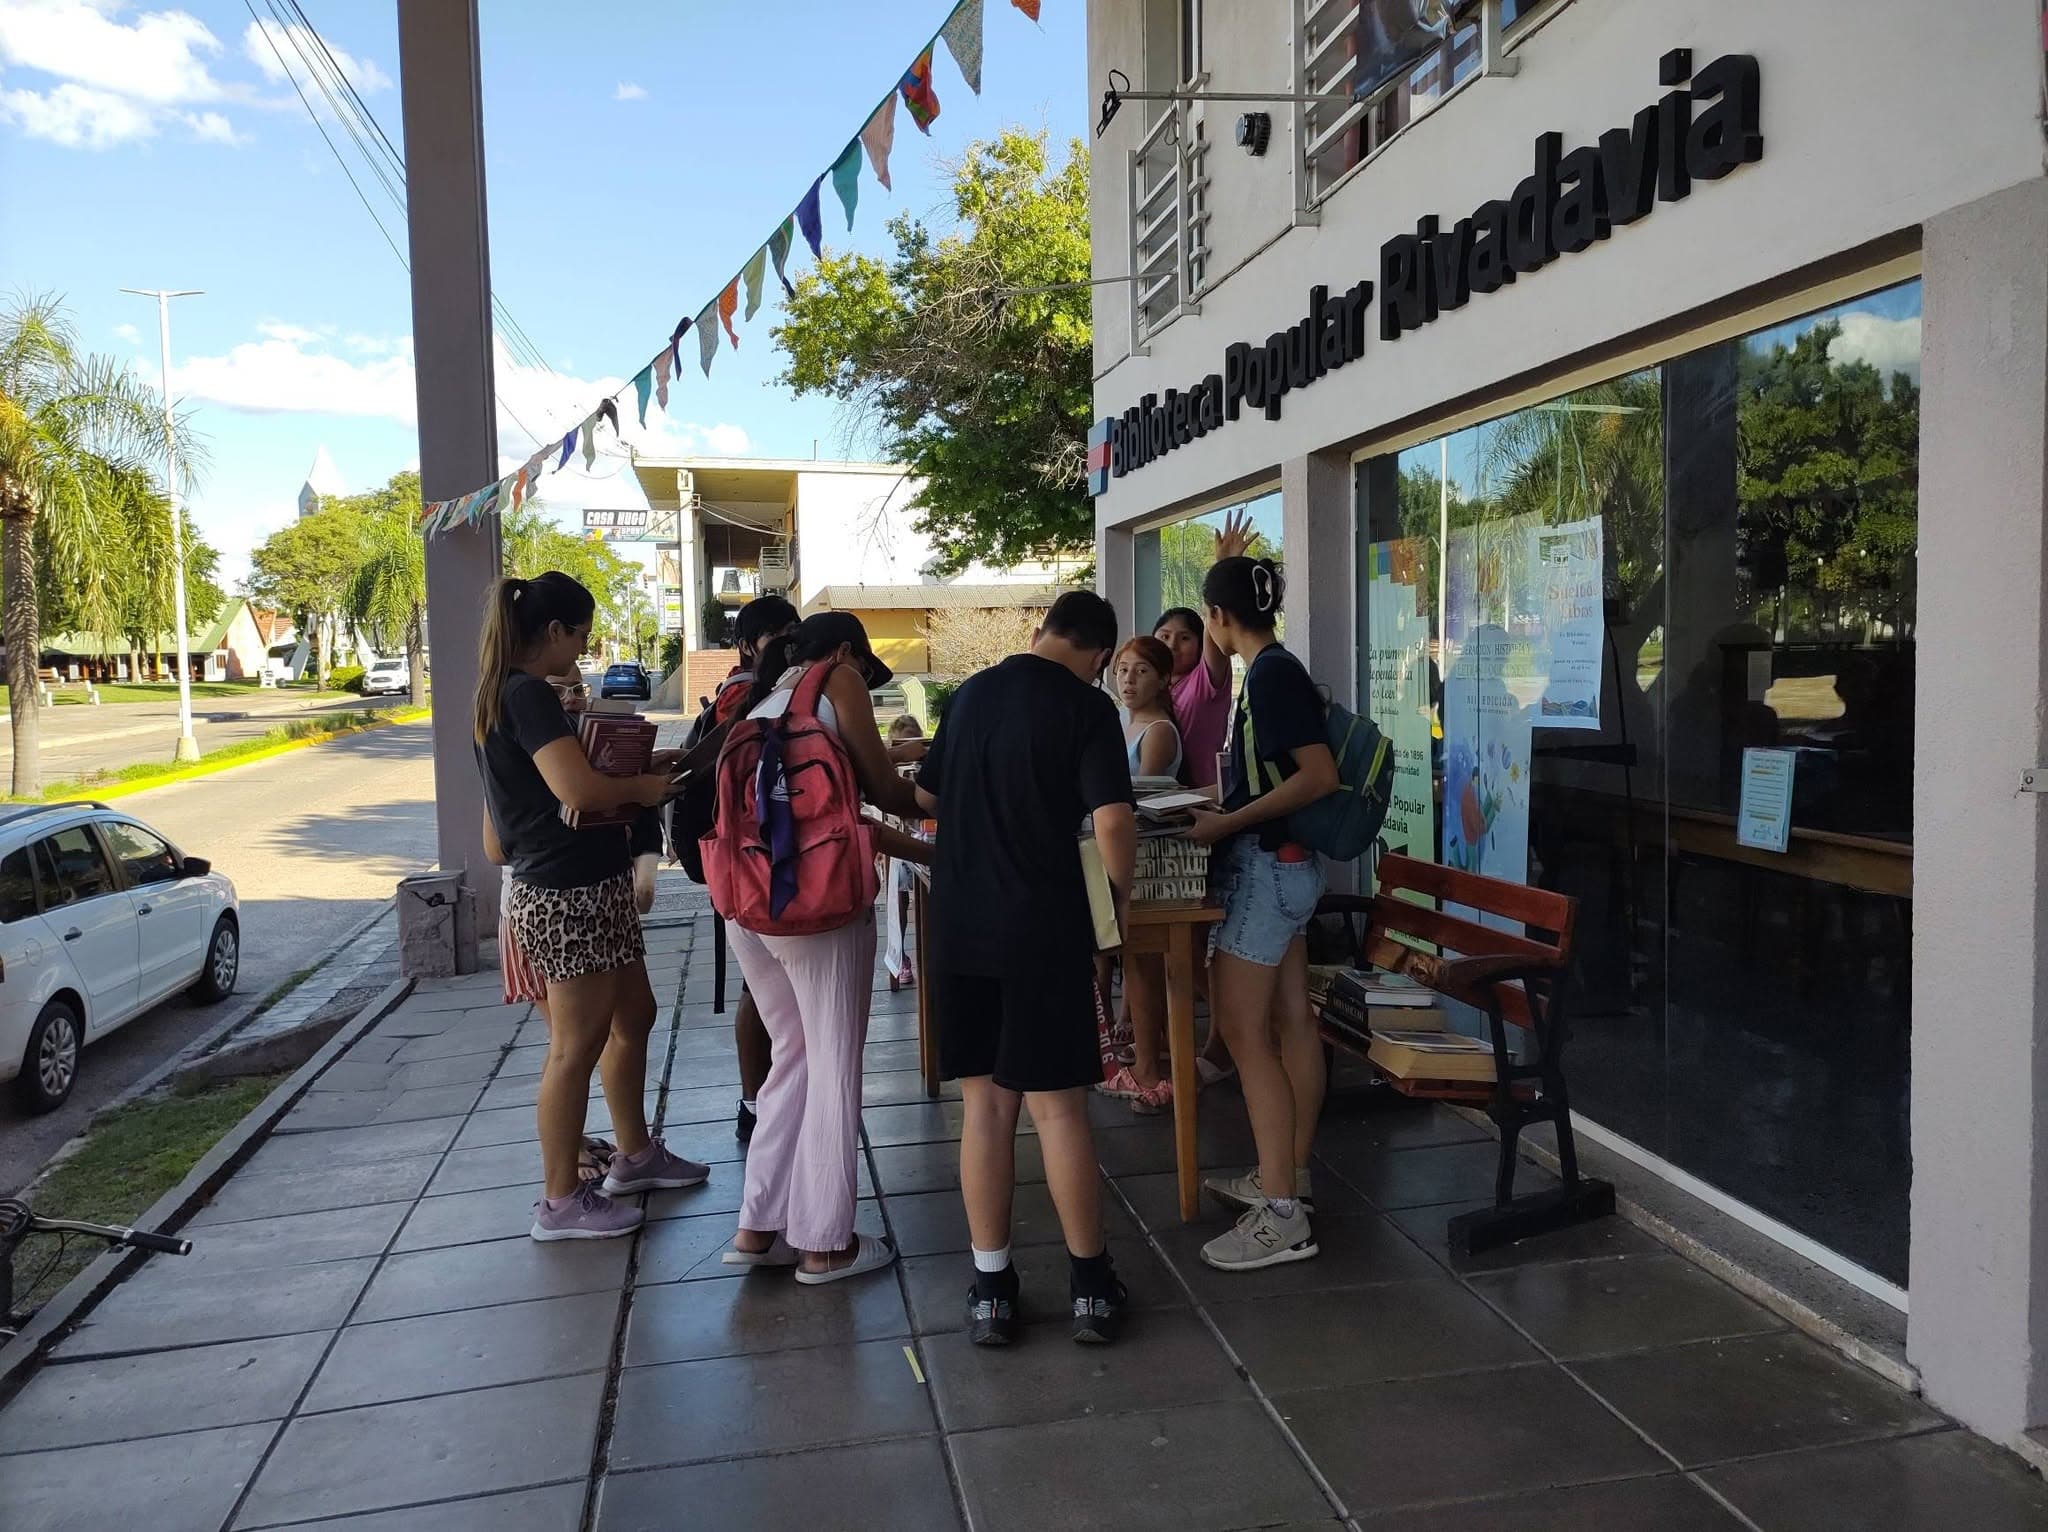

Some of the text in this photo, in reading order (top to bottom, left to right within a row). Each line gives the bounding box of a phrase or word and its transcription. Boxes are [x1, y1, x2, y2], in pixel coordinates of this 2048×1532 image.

[1112, 48, 1763, 477] Biblioteca Popular Rivadavia
[586, 511, 646, 526] CASA HUGO
[1394, 765, 1420, 777] omunidad
[1393, 795, 1426, 815] Popular
[1383, 816, 1408, 834] adavia
